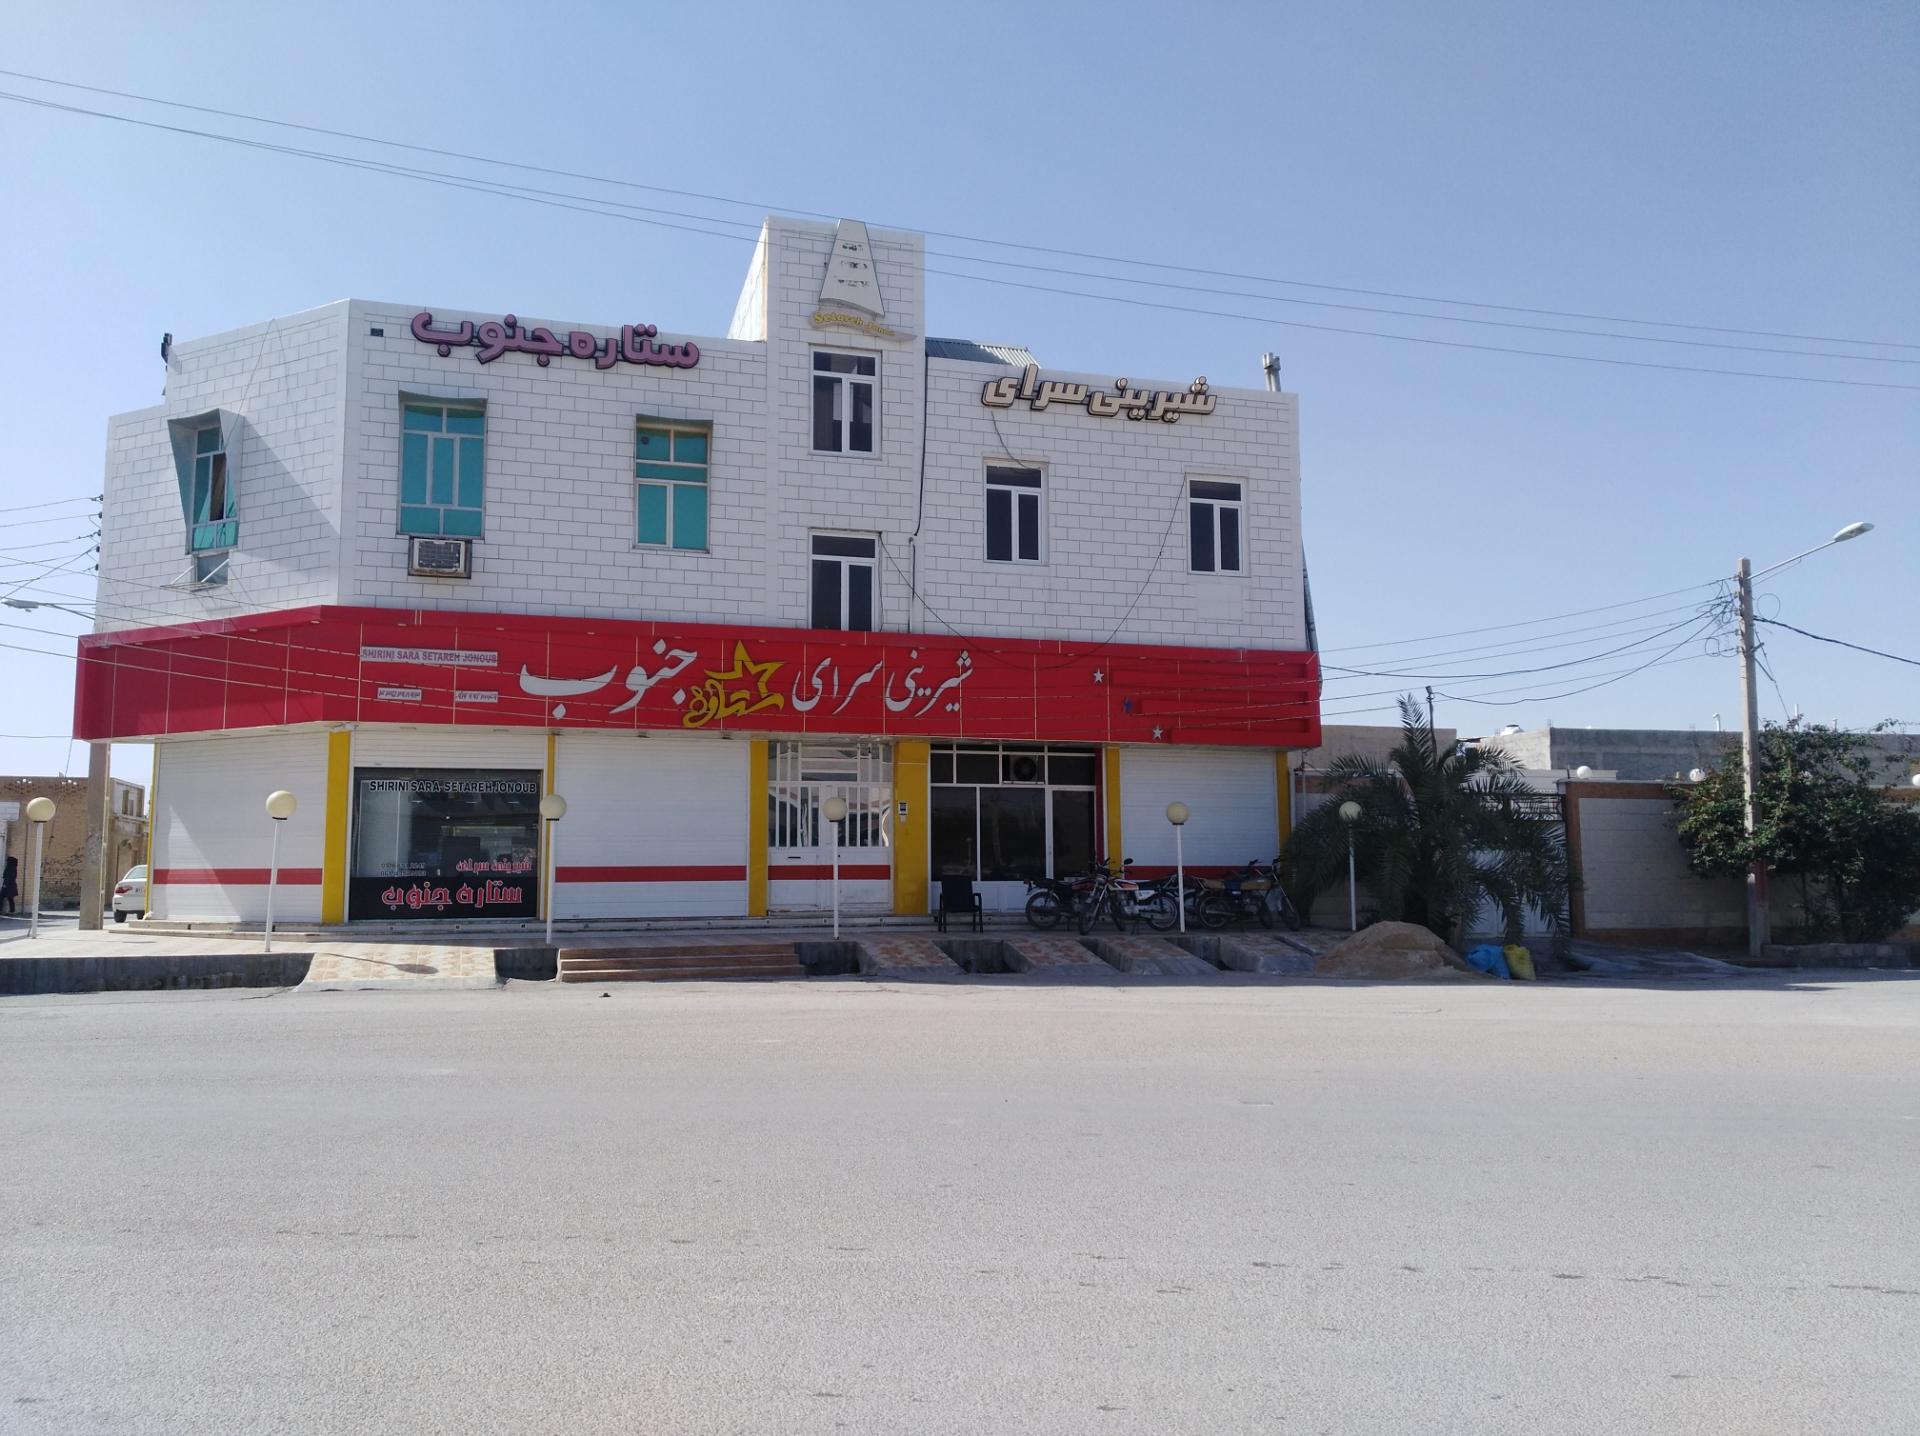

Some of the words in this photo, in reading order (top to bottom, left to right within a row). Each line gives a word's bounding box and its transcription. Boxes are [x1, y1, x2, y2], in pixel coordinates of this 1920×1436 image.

[411, 312, 564, 366] جنوب
[568, 323, 700, 369] ستاره
[981, 363, 1089, 411] سرای
[1088, 375, 1217, 423] شیرینی
[397, 650, 420, 661] SARA
[519, 638, 698, 720] جنوب
[792, 657, 883, 716] سرای
[885, 649, 974, 717] شیرینی
[369, 780, 409, 792] SHIRINI
[410, 780, 441, 793] SARA
[443, 780, 493, 793] SETAREH
[494, 781, 537, 793] JONOUB
[381, 881, 453, 911] جنوب
[456, 879, 523, 908] ستاره
